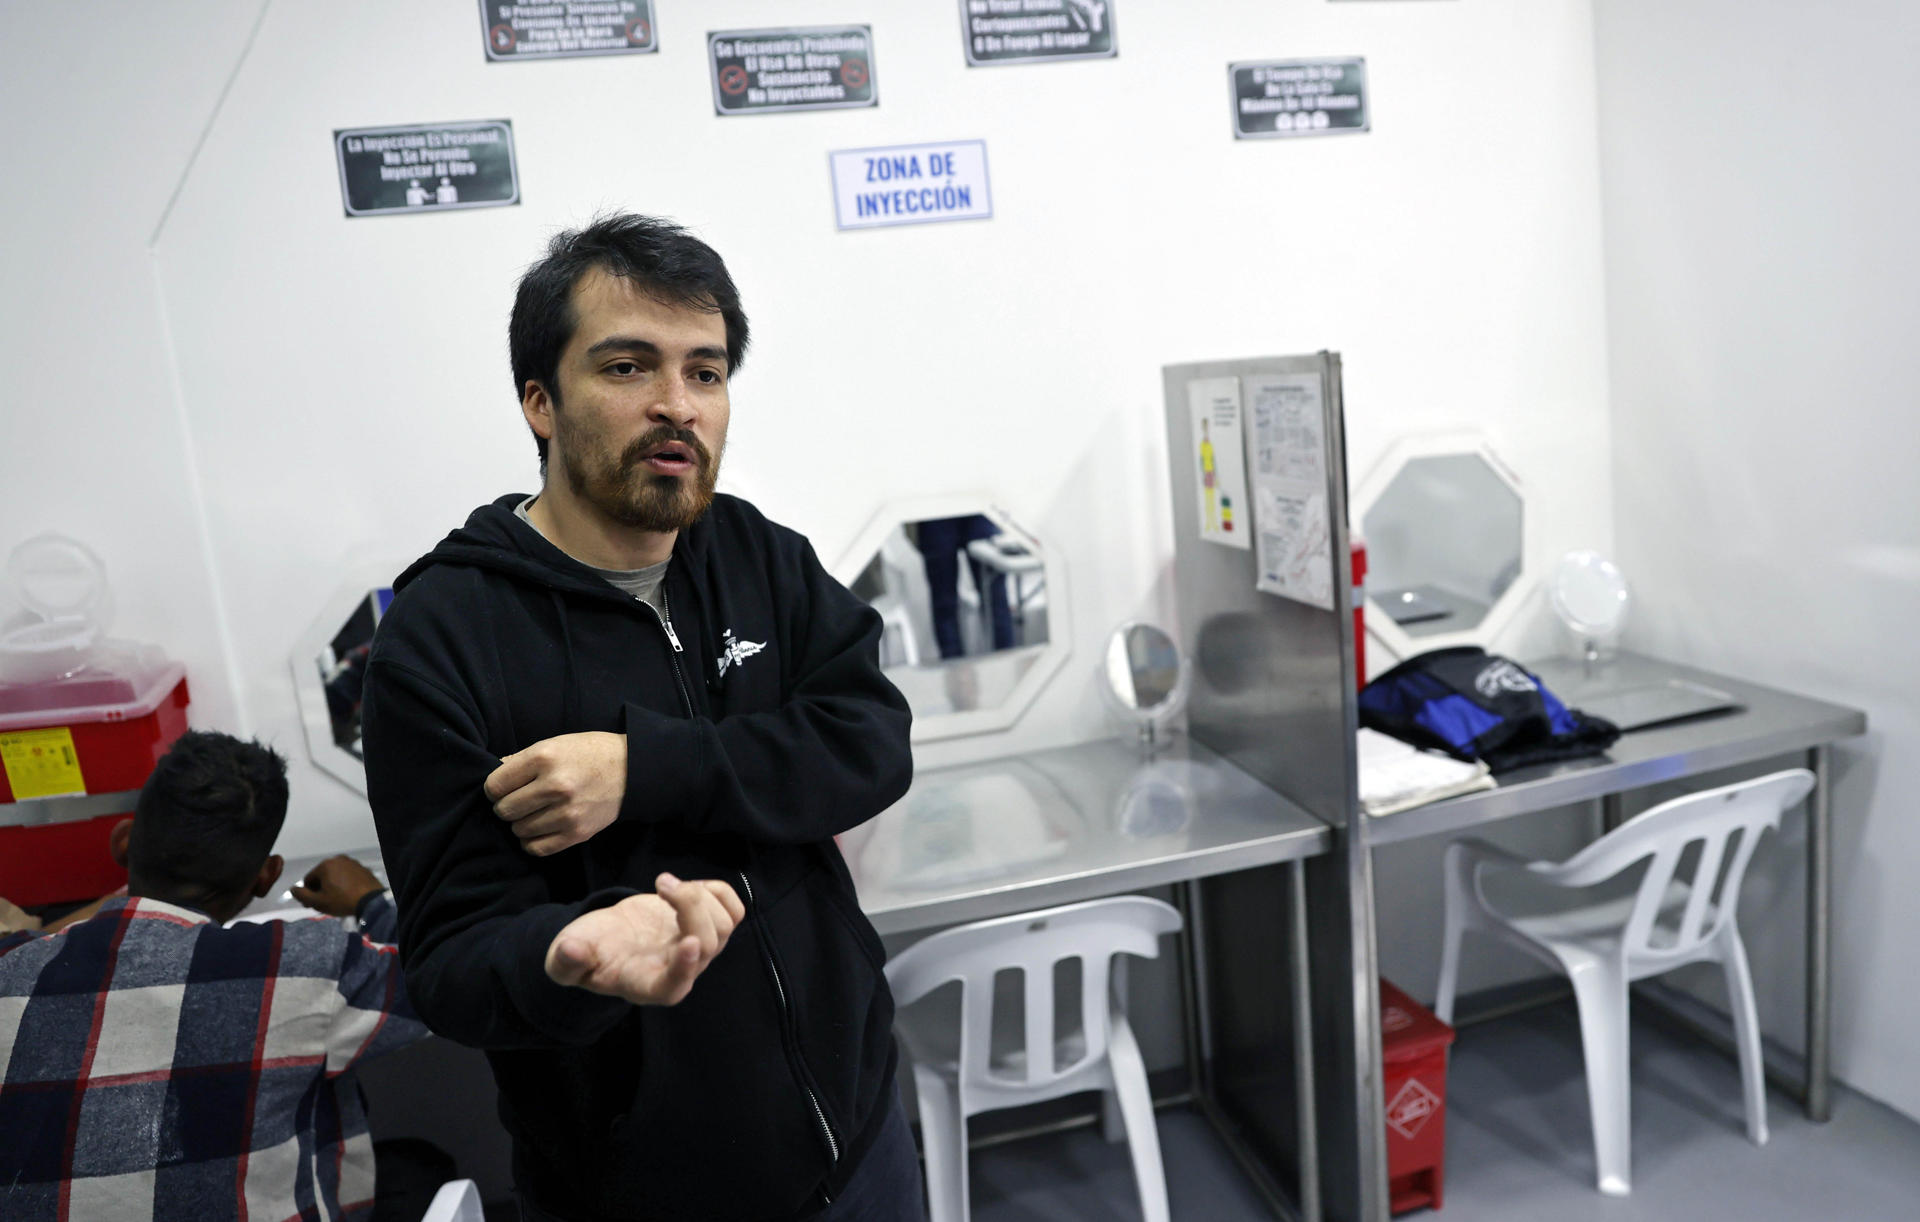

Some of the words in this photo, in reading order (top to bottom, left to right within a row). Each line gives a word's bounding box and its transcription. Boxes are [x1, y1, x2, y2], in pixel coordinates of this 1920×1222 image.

[715, 41, 733, 57] Se
[734, 39, 801, 56] Encuentra
[759, 55, 784, 71] Uso
[785, 54, 803, 70] De
[804, 53, 841, 69] Otras
[757, 70, 832, 87] Sustancias
[748, 87, 766, 103] No
[767, 85, 845, 104] Inyectables
[347, 138, 362, 153] La
[427, 132, 441, 148] Es
[442, 129, 499, 147] Personal
[383, 150, 400, 165] No
[402, 149, 418, 164] Se
[866, 155, 922, 183] ZONA
[929, 152, 956, 177] DE
[856, 178, 972, 218] INYECCIÓN
